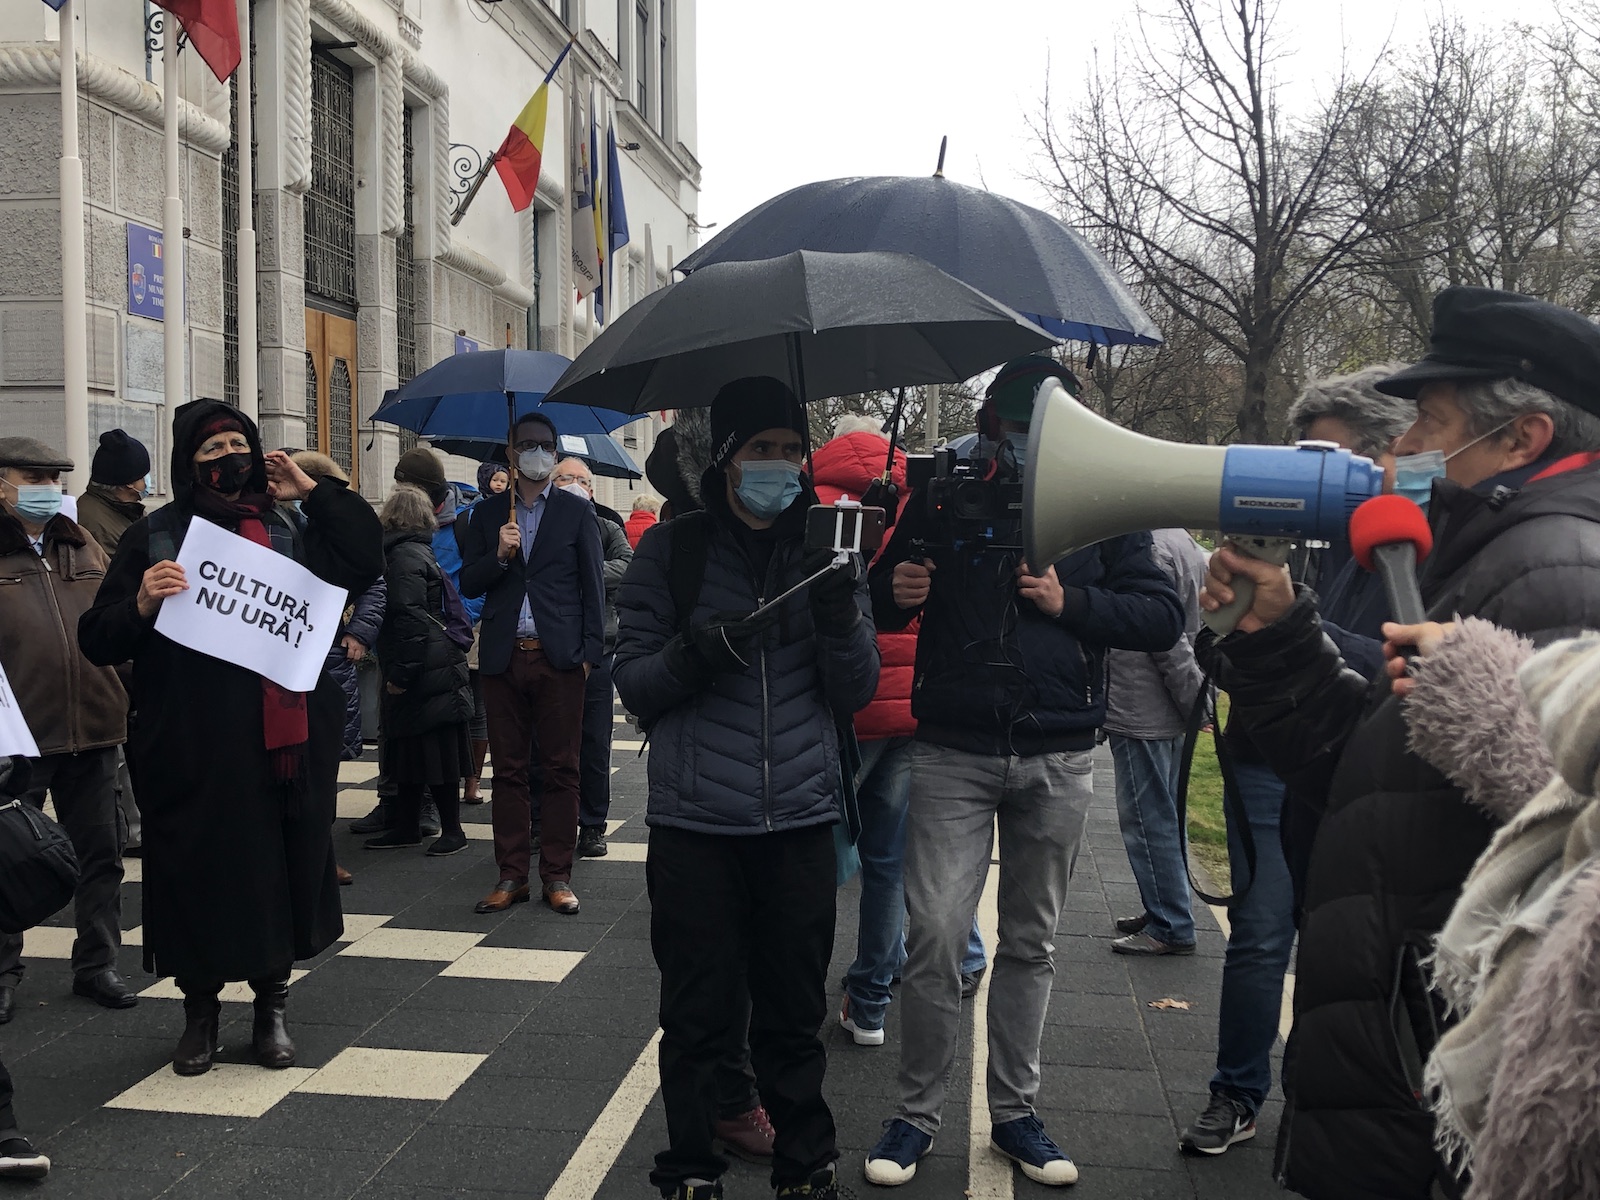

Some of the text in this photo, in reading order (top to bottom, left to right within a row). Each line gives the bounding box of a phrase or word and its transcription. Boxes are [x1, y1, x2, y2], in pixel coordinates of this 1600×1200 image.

[1238, 500, 1299, 509] MONACOR
[196, 587, 237, 615] NU
[199, 560, 314, 632] CULTURĂ,
